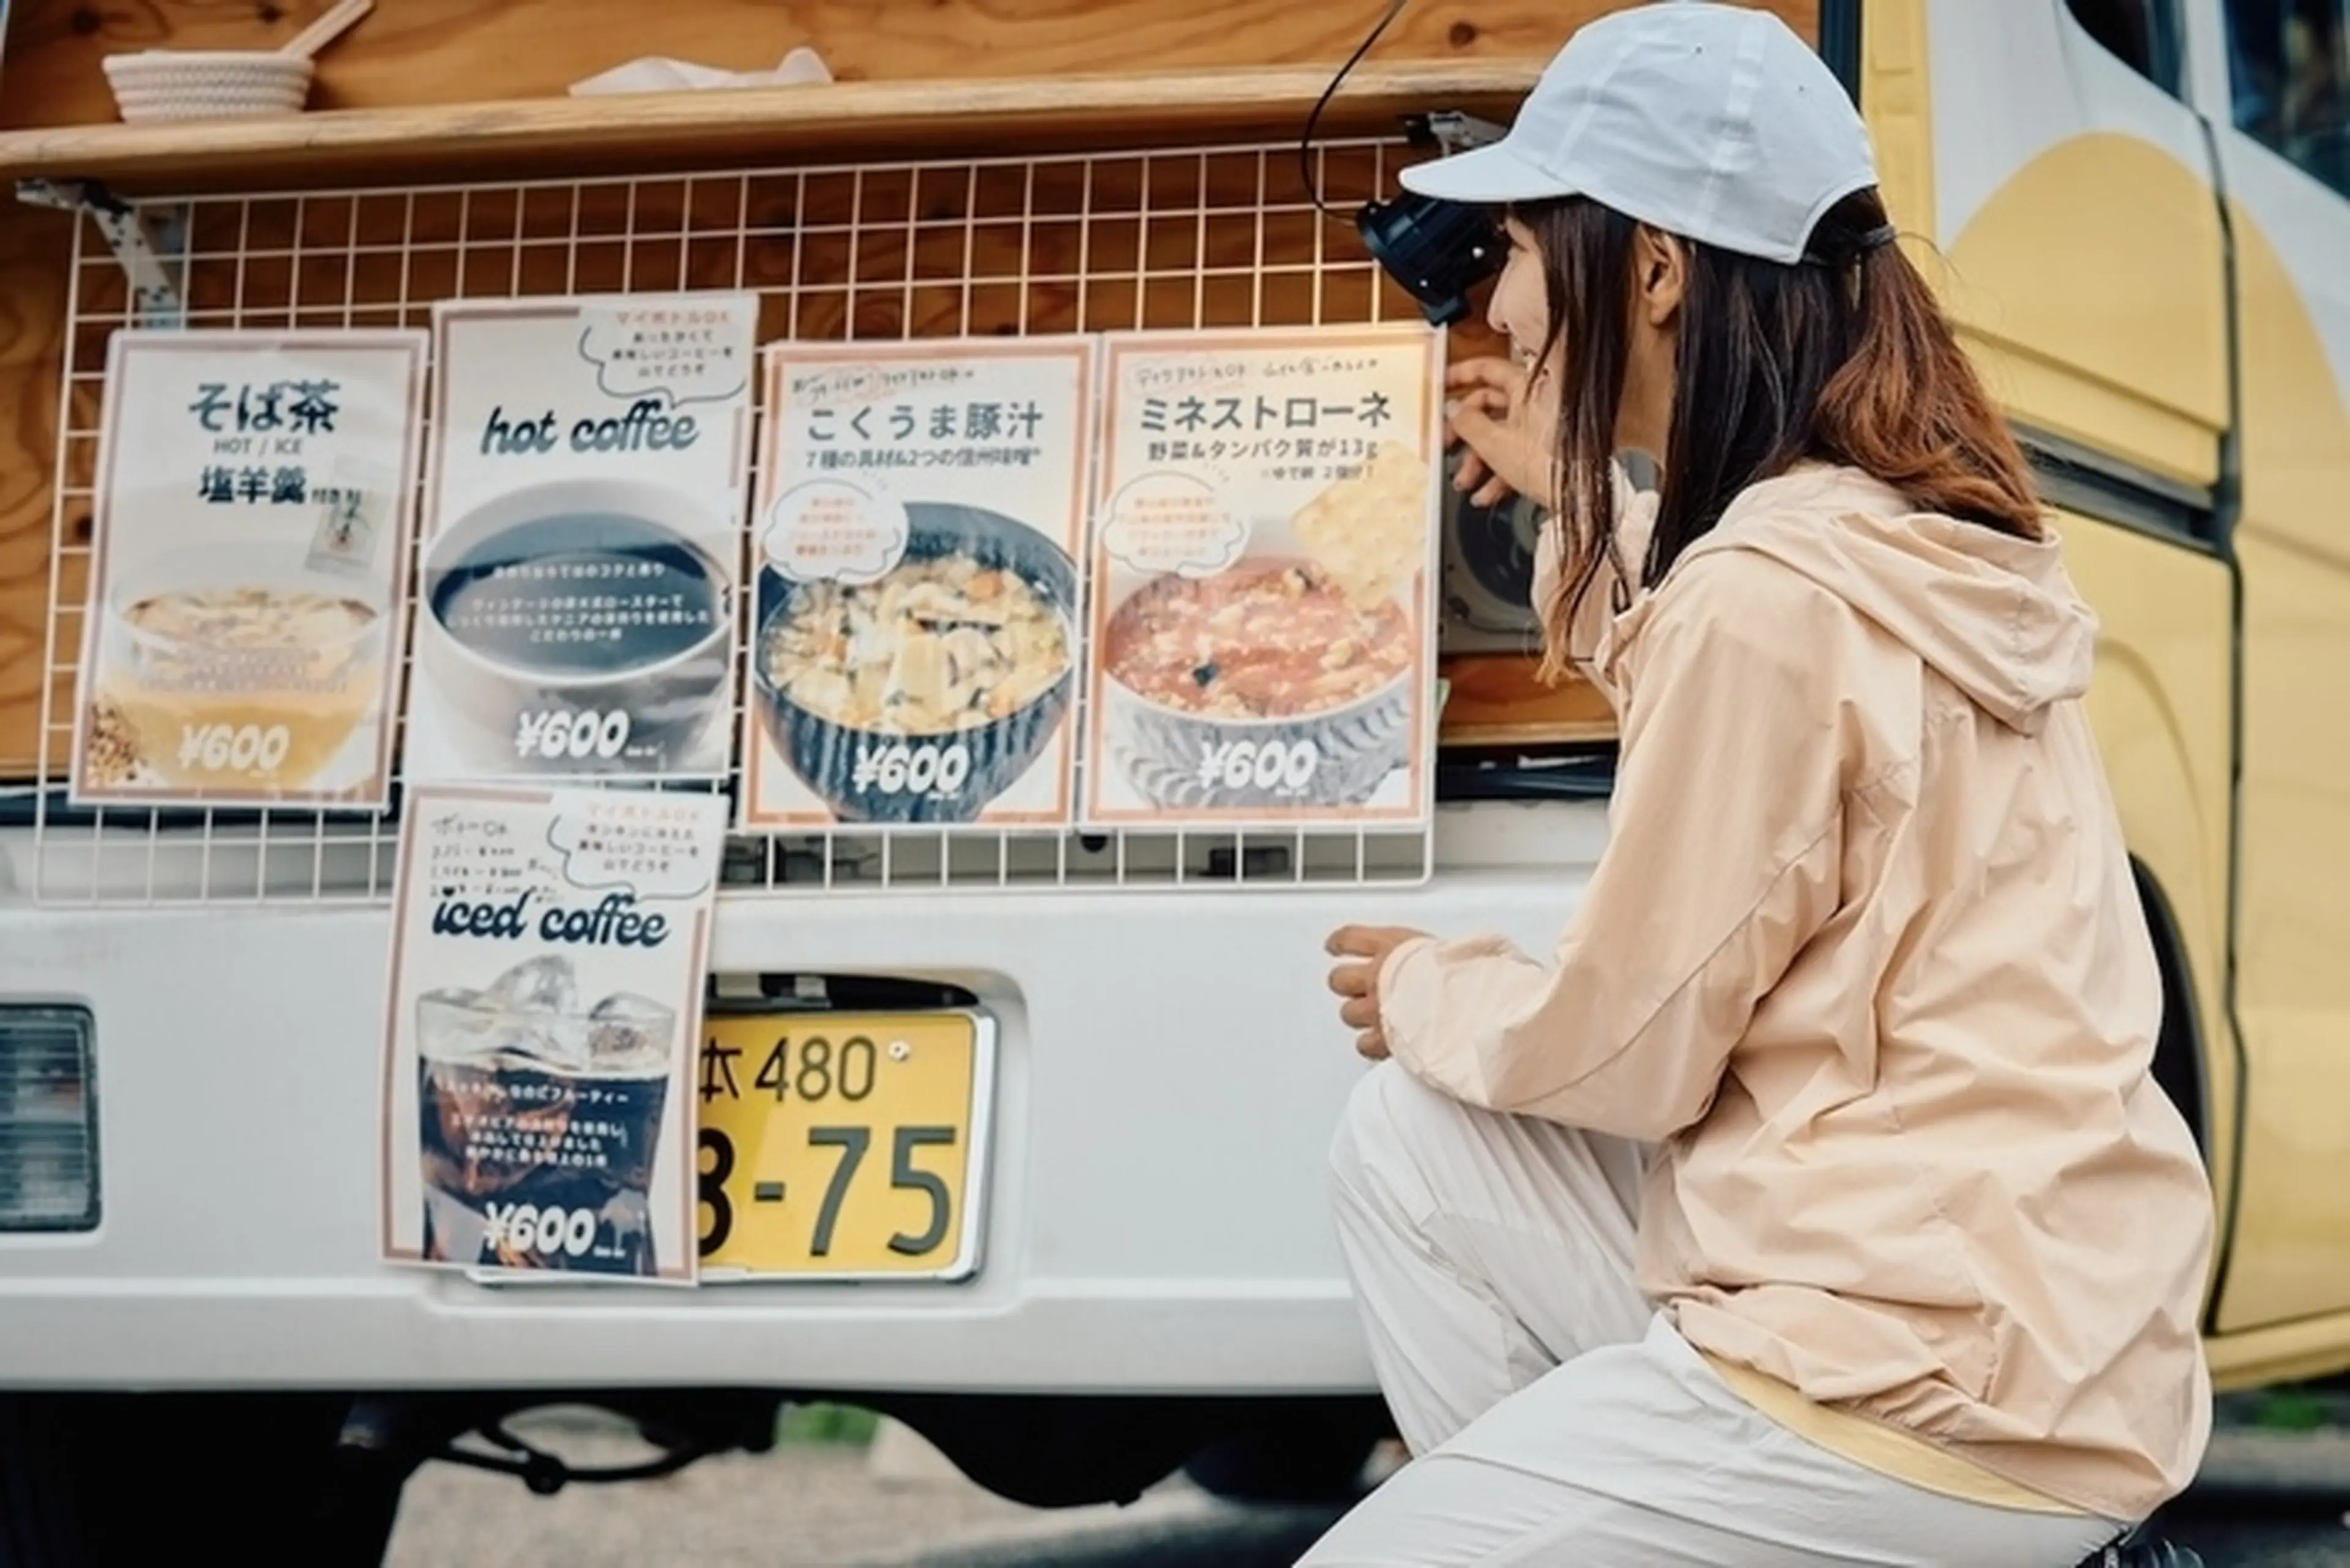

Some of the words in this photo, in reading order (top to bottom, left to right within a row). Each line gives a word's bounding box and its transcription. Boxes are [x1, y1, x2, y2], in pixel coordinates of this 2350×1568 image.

[189, 378, 340, 435] そば茶
[480, 405, 557, 455] hot
[569, 399, 700, 453] coffee
[807, 400, 1044, 442] こくうま豚汁
[1140, 392, 1392, 433] ミネストローネ
[213, 438, 252, 455] HOT
[275, 436, 302, 455] ICE
[177, 723, 290, 771] ¥600
[514, 708, 630, 761] ¥600
[851, 744, 970, 794] ¥600
[1198, 739, 1319, 791] ¥600
[432, 894, 528, 940] iced
[540, 894, 671, 947] coffee
[754, 1036, 876, 1102] 480
[484, 1201, 596, 1258] ¥600
